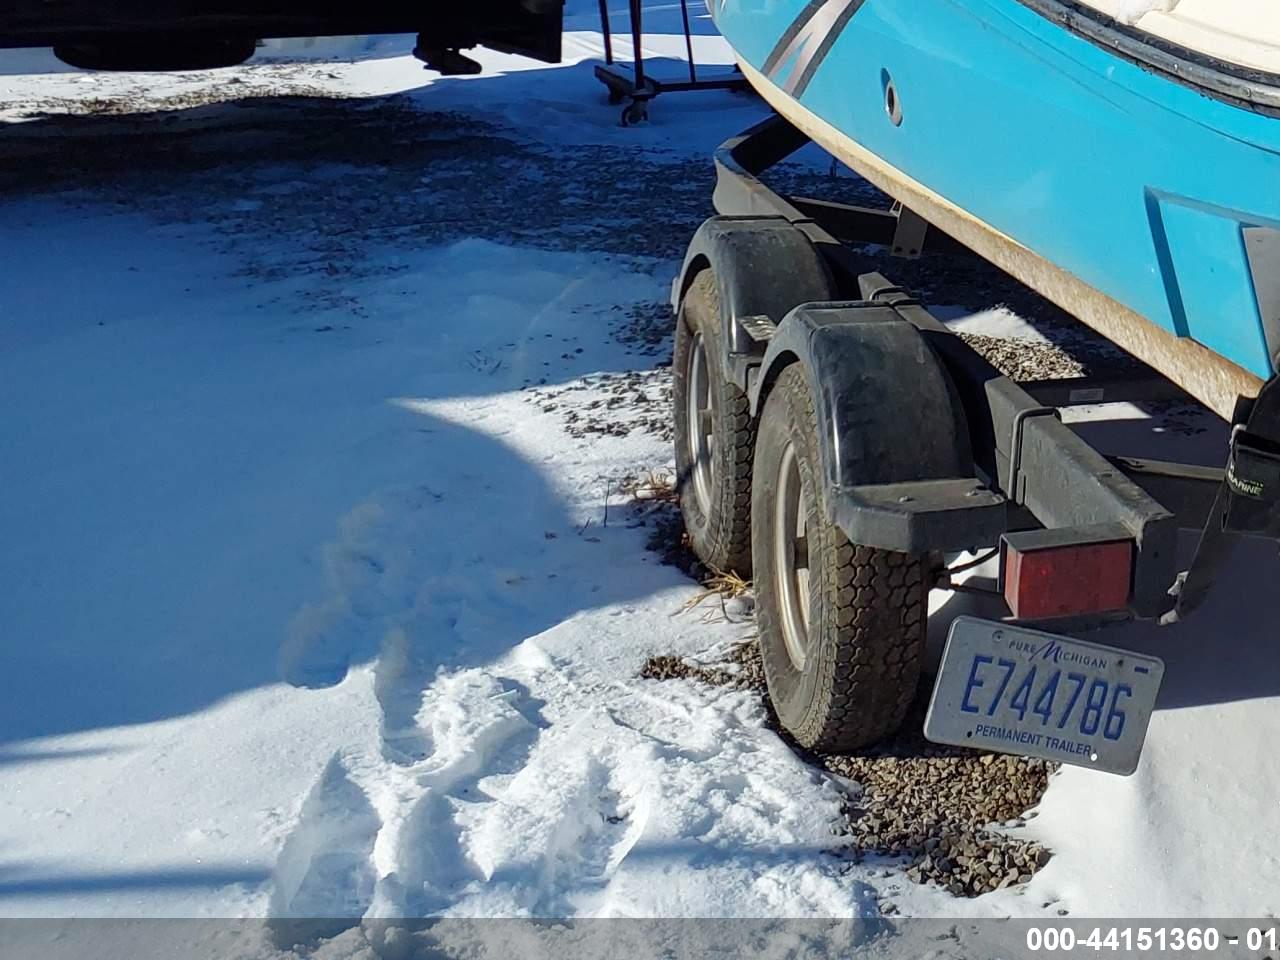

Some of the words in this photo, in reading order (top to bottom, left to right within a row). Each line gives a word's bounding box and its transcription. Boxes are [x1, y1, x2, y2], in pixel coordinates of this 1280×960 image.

[1009, 640, 1036, 653] PURE
[1029, 640, 1107, 669] MICHIGAN
[960, 653, 1132, 741] E744786
[975, 724, 1042, 746] PERMANENT
[1045, 735, 1092, 756] TRAILER
